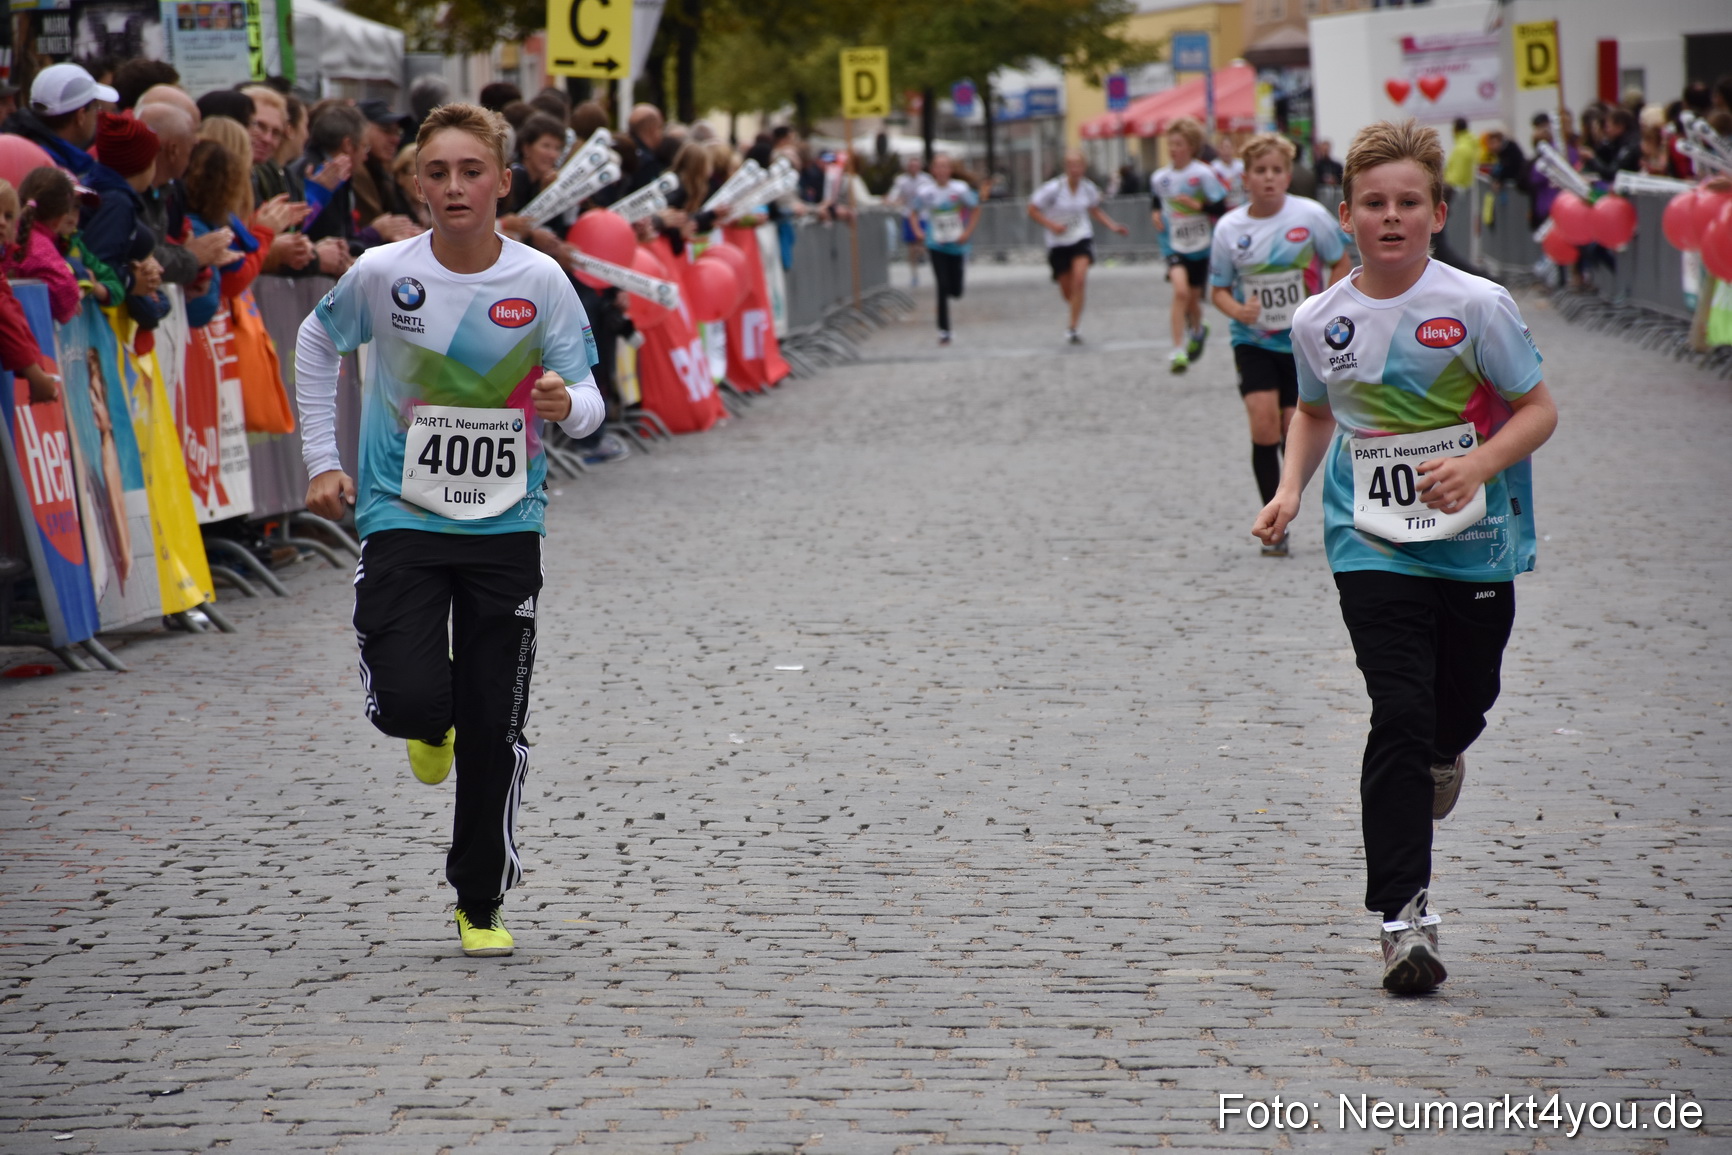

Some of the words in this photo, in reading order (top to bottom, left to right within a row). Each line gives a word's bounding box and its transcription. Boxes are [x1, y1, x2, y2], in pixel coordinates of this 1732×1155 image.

[569, 0, 609, 48] C
[1526, 41, 1550, 75] D
[856, 69, 877, 102] D
[1252, 284, 1300, 309] 030
[391, 312, 426, 328] PARTL
[496, 305, 532, 321] Hervis
[391, 321, 425, 334] Neumarkt
[1423, 326, 1461, 341] Hervis
[1332, 362, 1358, 372] eumarkt
[415, 417, 452, 428] PARTL
[455, 418, 509, 431] Neumarkt
[417, 434, 516, 478] 4005
[1355, 448, 1392, 460] PARTL
[1394, 440, 1454, 457] Neumarkt
[1368, 458, 1442, 507] 40
[444, 487, 486, 505] Louis
[1405, 517, 1436, 530] Tim
[1475, 590, 1496, 600] JAKO
[506, 628, 531, 743] Raiba-Burgthann.de
